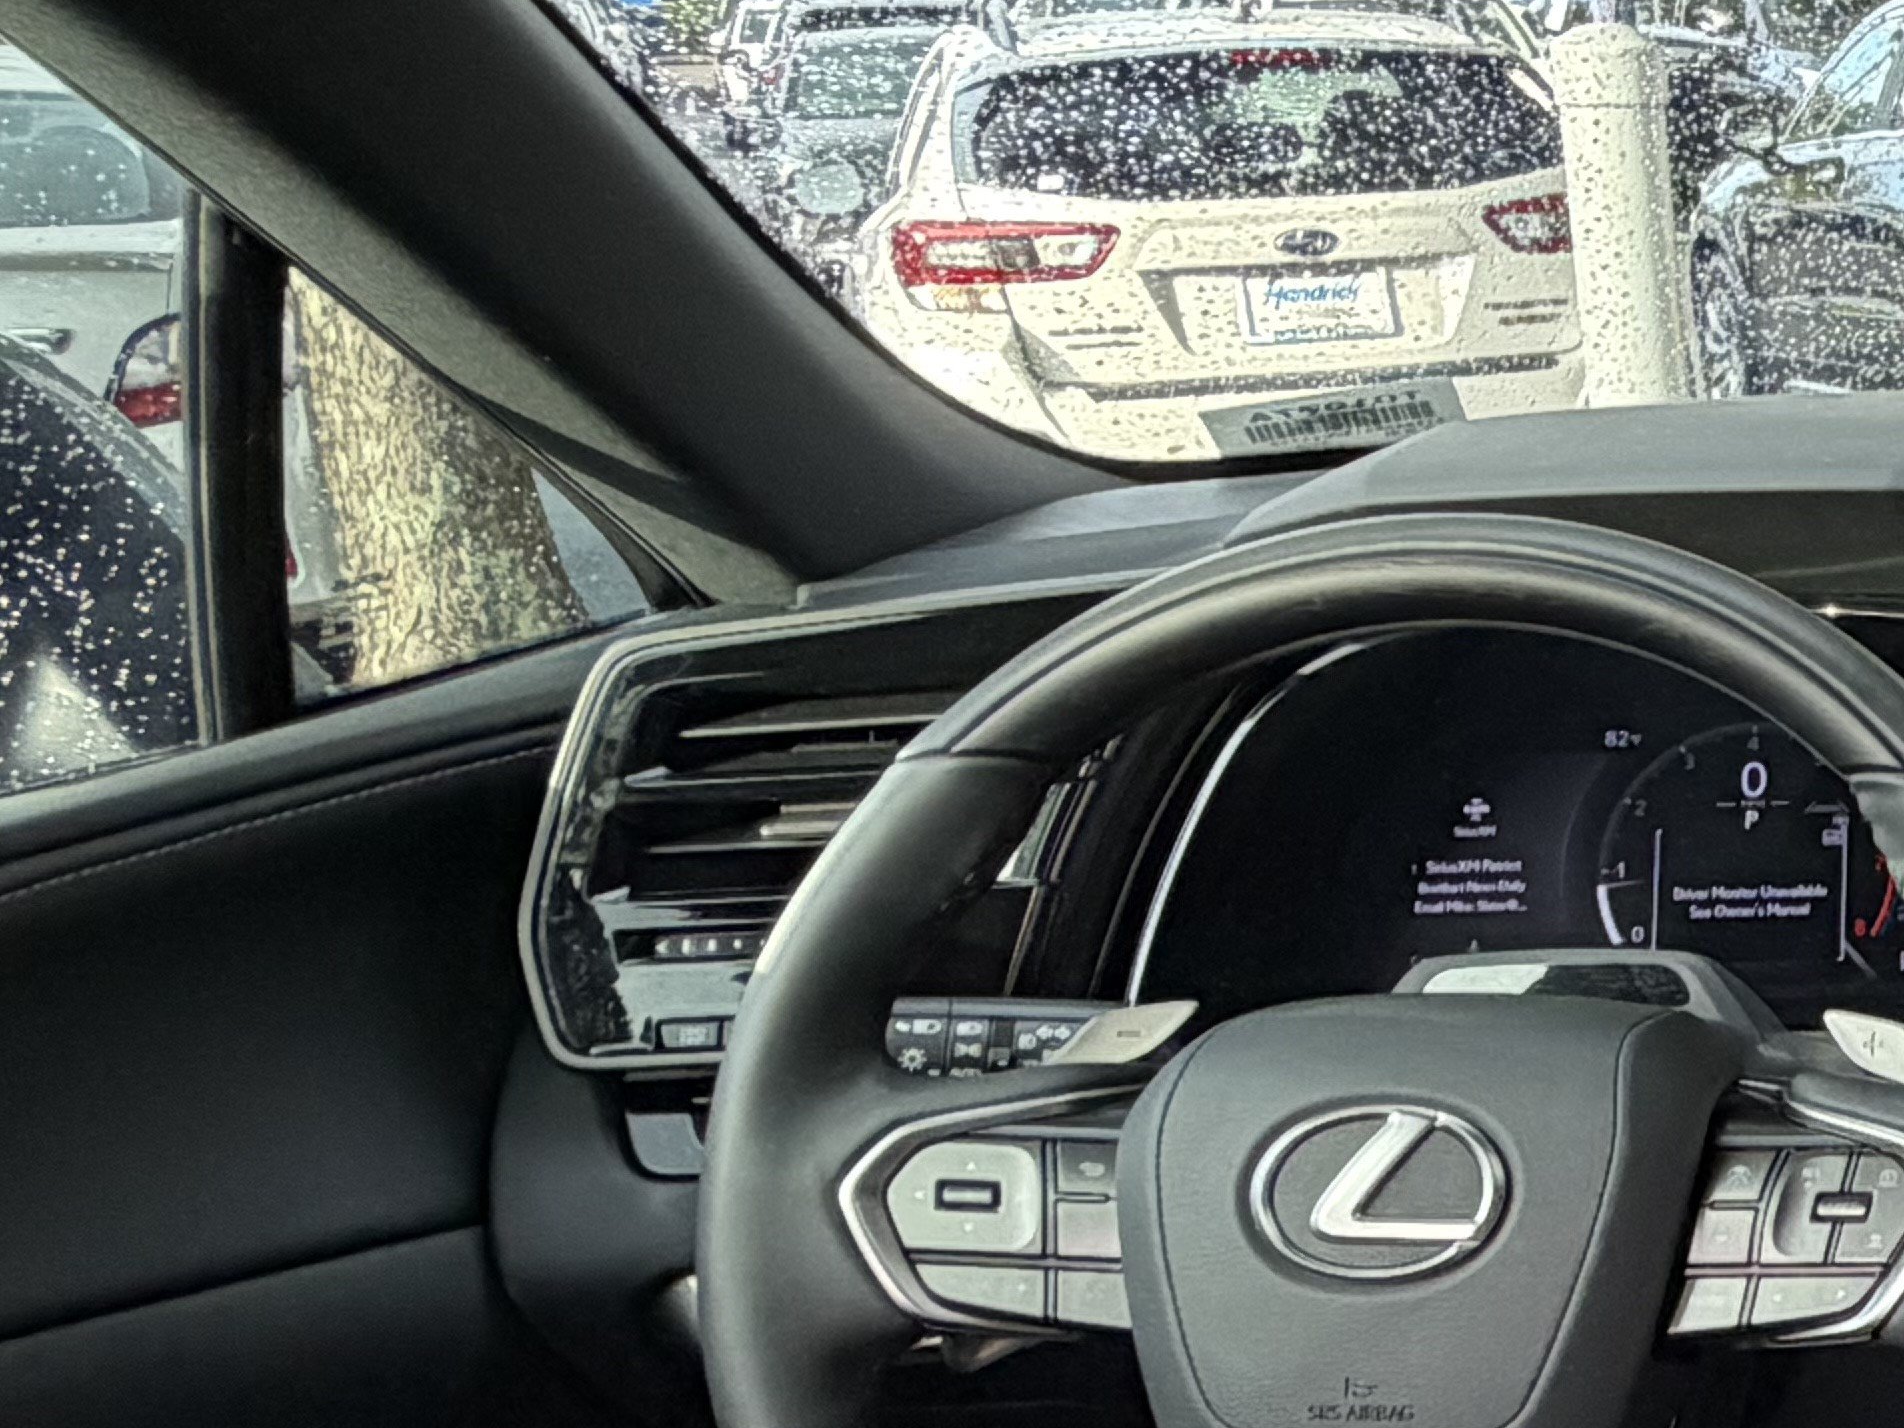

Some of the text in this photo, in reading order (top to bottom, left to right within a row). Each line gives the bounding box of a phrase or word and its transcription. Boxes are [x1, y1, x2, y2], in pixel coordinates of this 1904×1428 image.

[1740, 760, 1769, 799] 0
[1744, 810, 1760, 831] P
[1672, 882, 1829, 902] Driver Monitor Unavailable
[1689, 901, 1812, 920] See Owner's Manual
[1630, 925, 1645, 944] 0
[1345, 1403, 1416, 1422] AIRBAG
